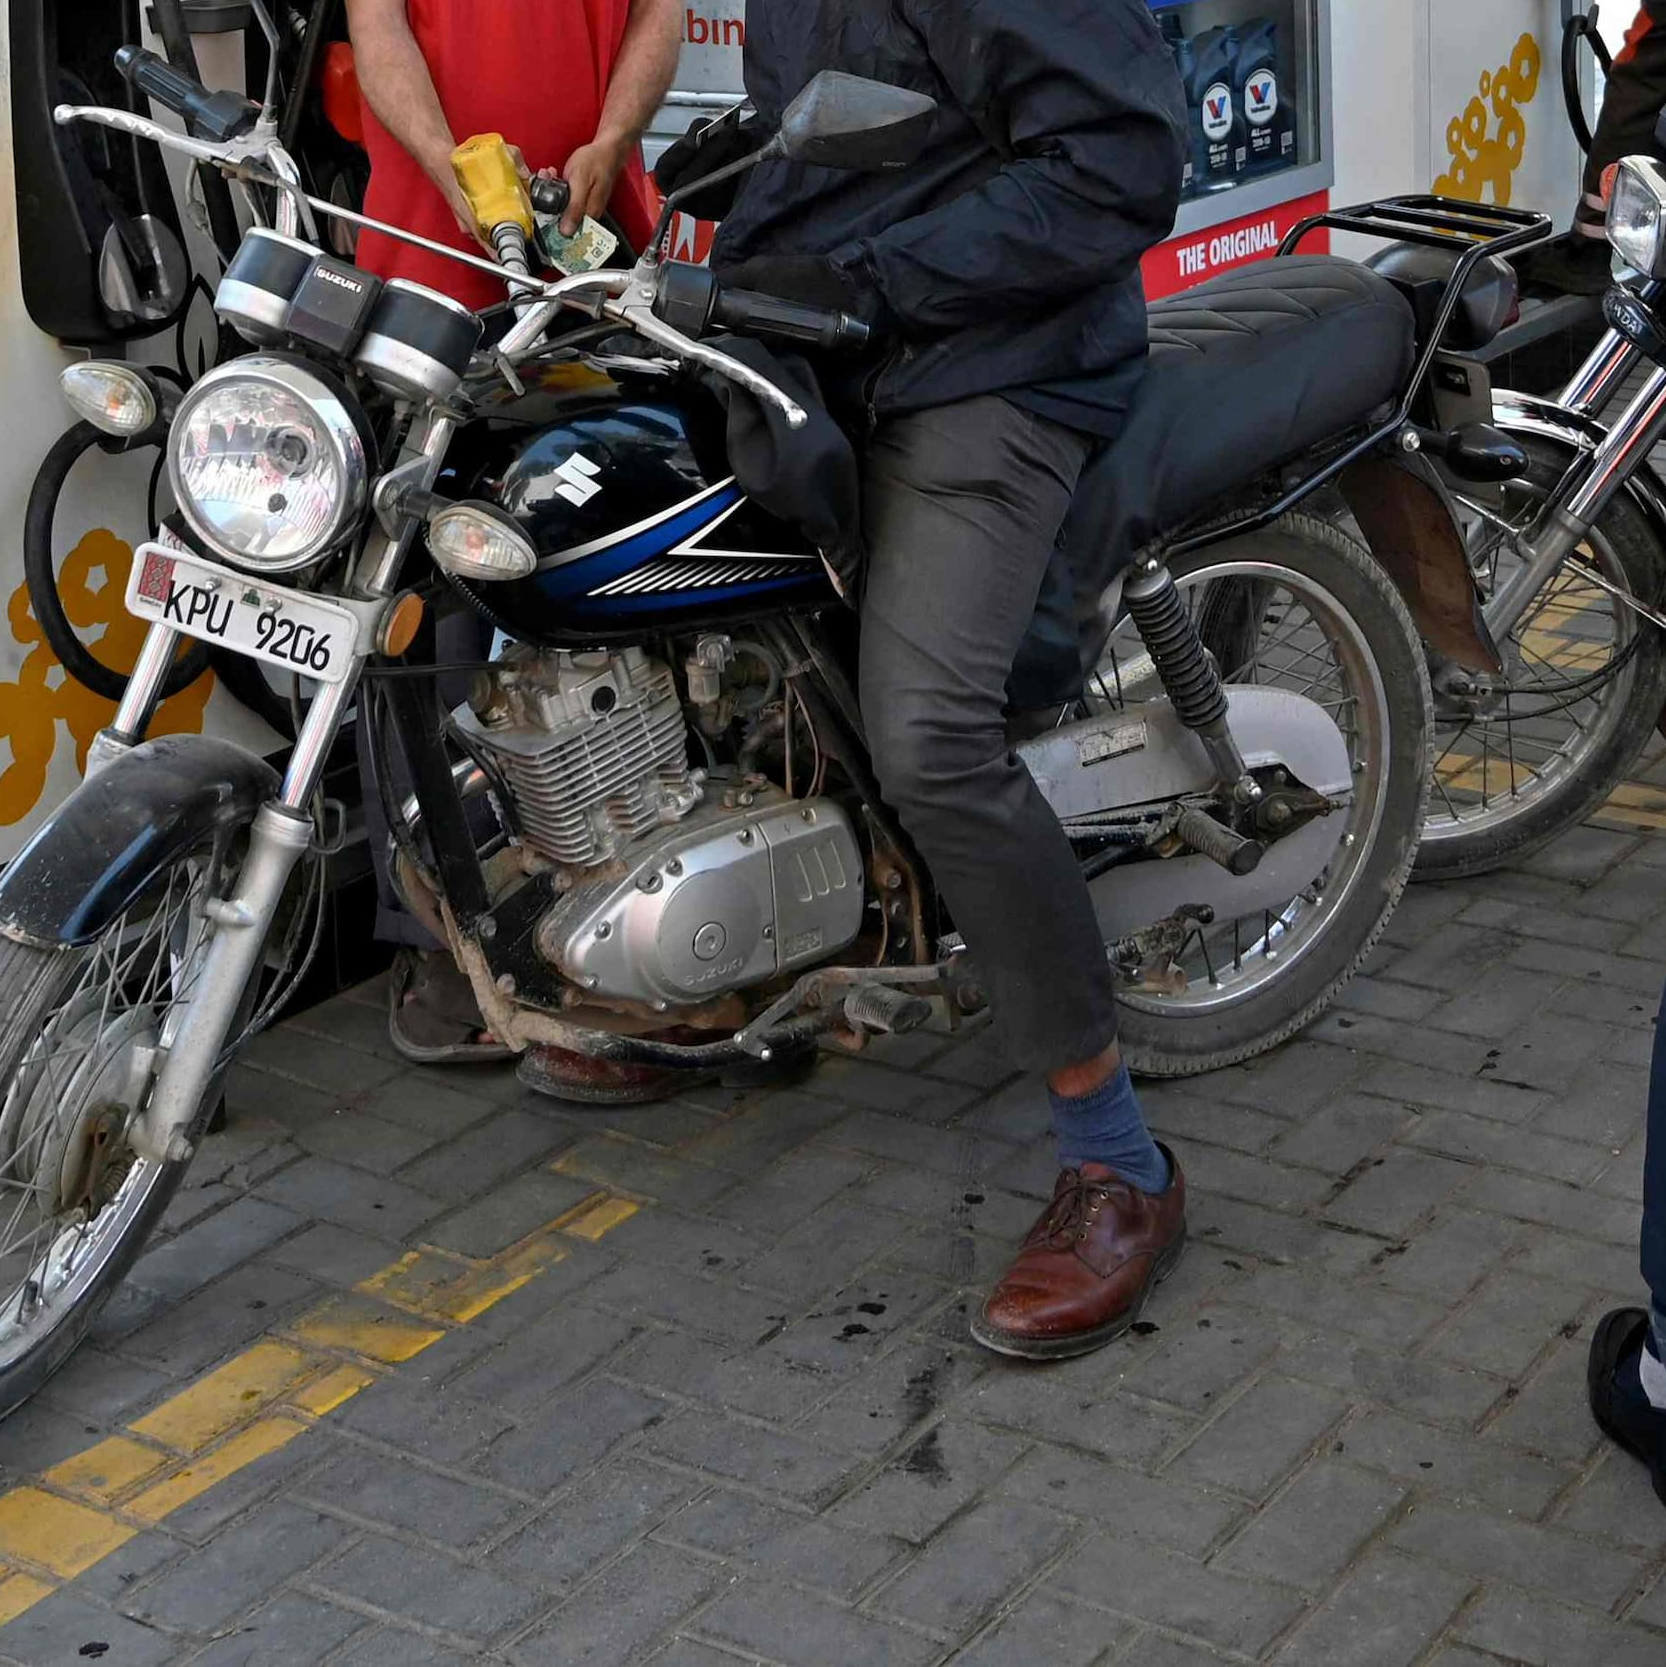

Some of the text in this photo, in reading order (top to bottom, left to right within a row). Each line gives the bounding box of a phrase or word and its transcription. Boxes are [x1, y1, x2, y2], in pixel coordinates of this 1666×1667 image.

[1177, 221, 1278, 276] THE ORIGINAL
[317, 268, 363, 293] SUZUKI
[164, 580, 332, 672] KPU 9206
[685, 957, 743, 986] SUZUKI
